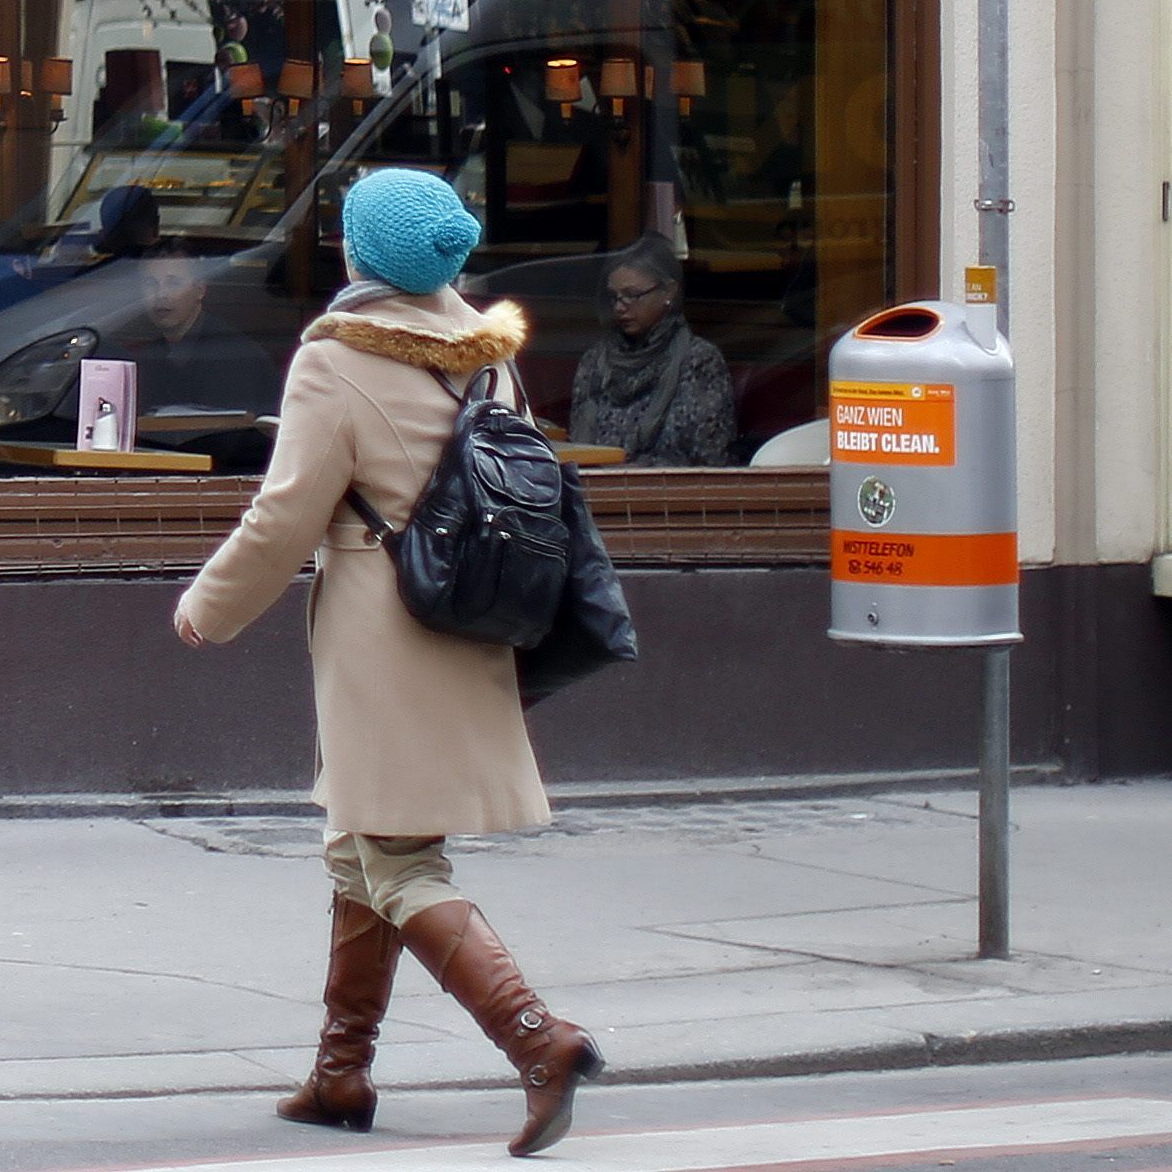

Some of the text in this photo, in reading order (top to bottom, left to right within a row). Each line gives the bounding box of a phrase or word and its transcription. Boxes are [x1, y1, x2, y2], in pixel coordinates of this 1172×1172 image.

[836, 404, 903, 427] GANZ WIEN
[837, 430, 940, 454] BLEIBT CLEAN.
[863, 560, 903, 576] 546 48
